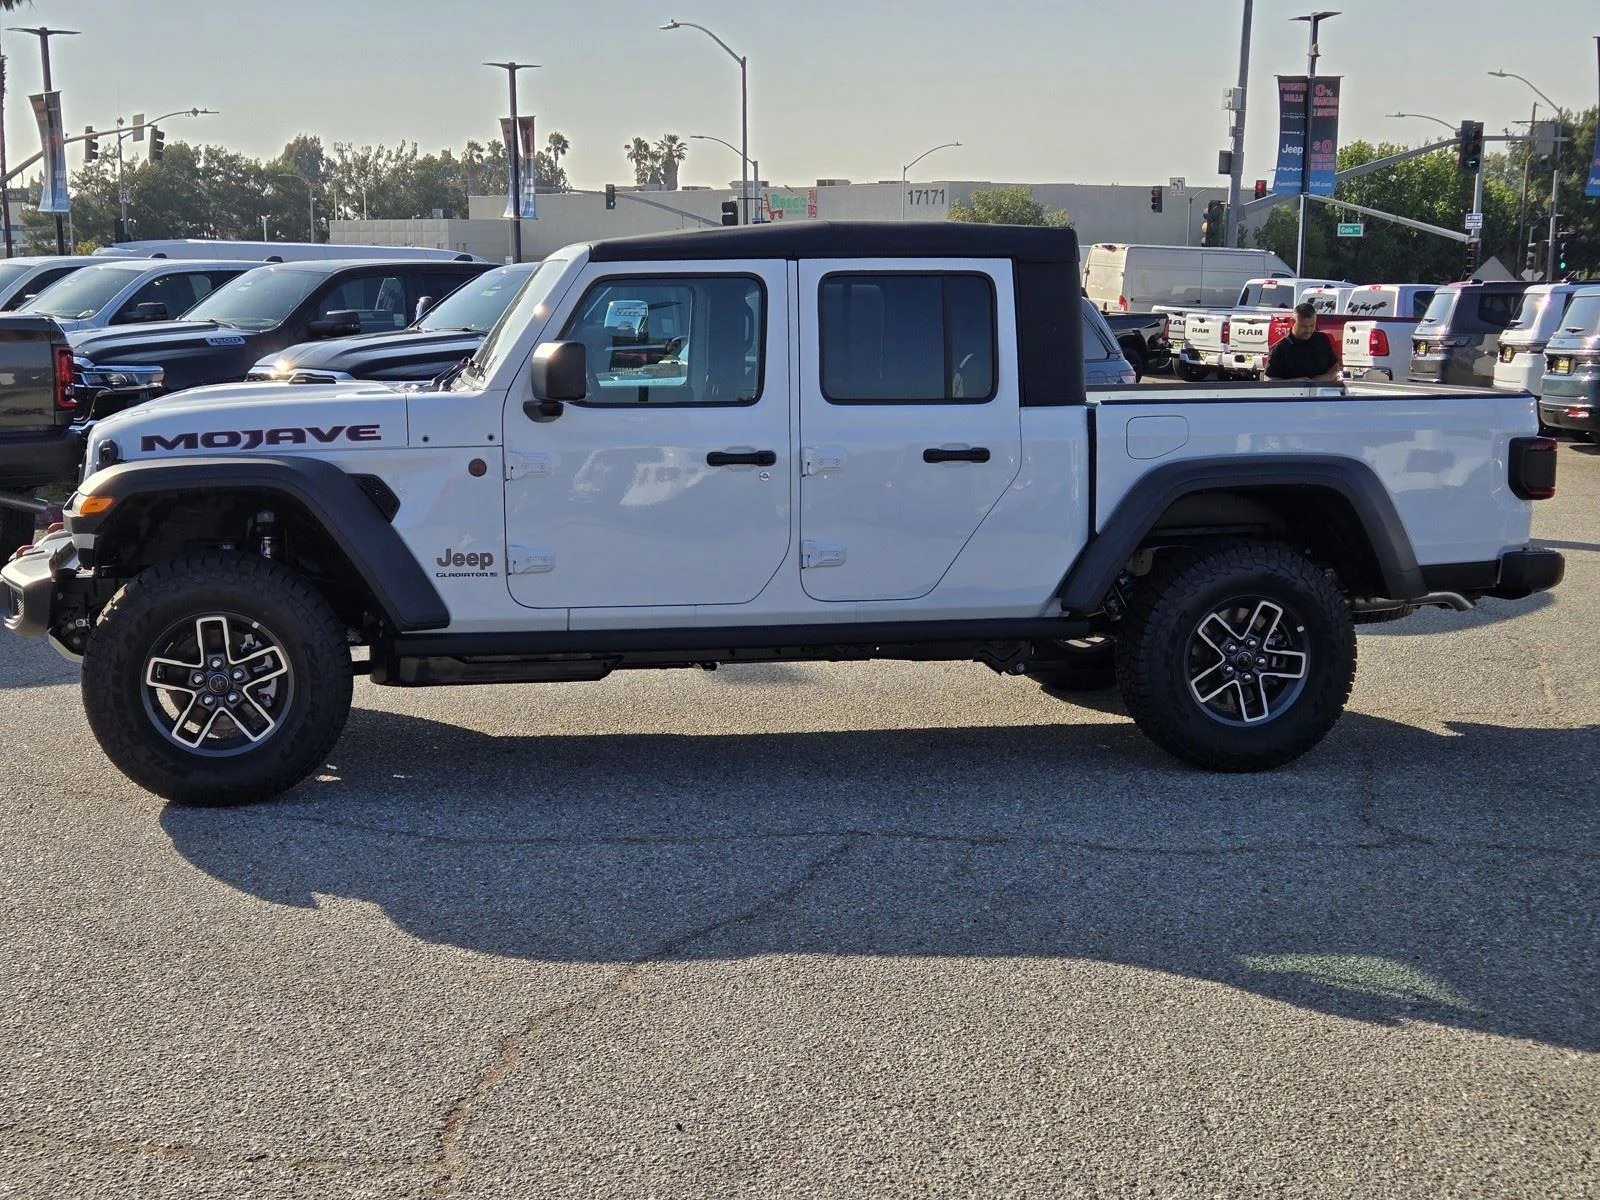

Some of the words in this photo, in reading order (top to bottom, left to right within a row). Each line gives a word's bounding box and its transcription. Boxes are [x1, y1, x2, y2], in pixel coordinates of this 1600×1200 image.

[1281, 143, 1304, 156] Jeep
[907, 189, 945, 206] 17171
[1237, 328, 1264, 336] RAM
[140, 424, 382, 451] MOJAVE
[436, 548, 494, 570] Jeep
